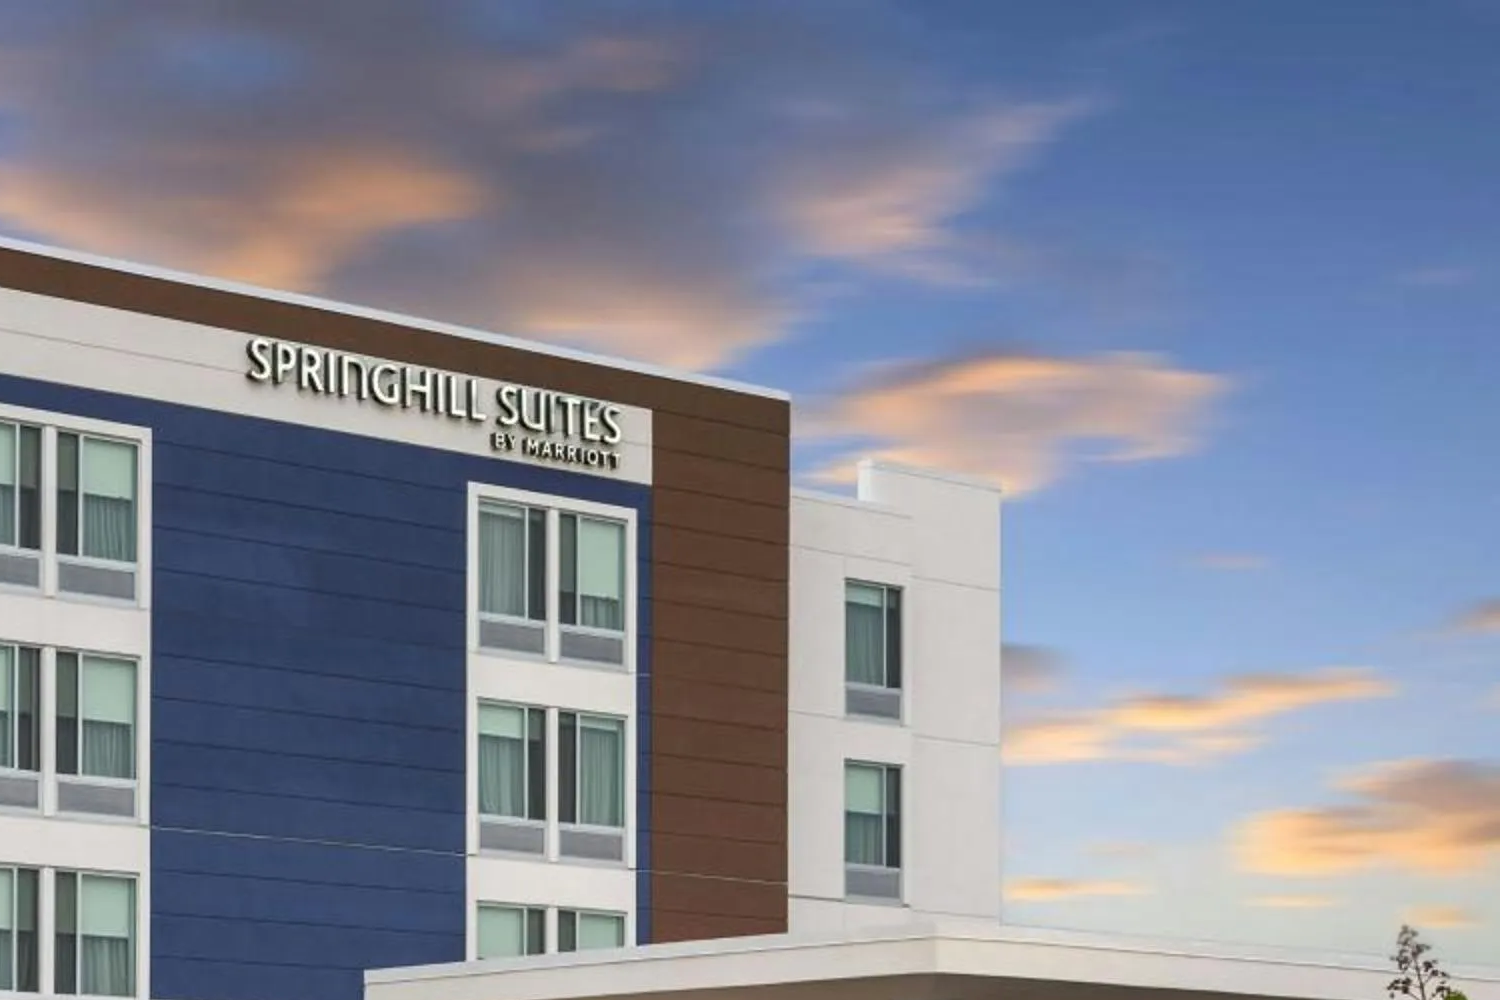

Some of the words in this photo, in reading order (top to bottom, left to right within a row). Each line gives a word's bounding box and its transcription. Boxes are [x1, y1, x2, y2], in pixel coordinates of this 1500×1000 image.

[246, 338, 487, 420] SPRINGHILL
[497, 385, 621, 444] SUITES
[491, 432, 517, 449] BY
[523, 437, 621, 468] MARRIOTT
